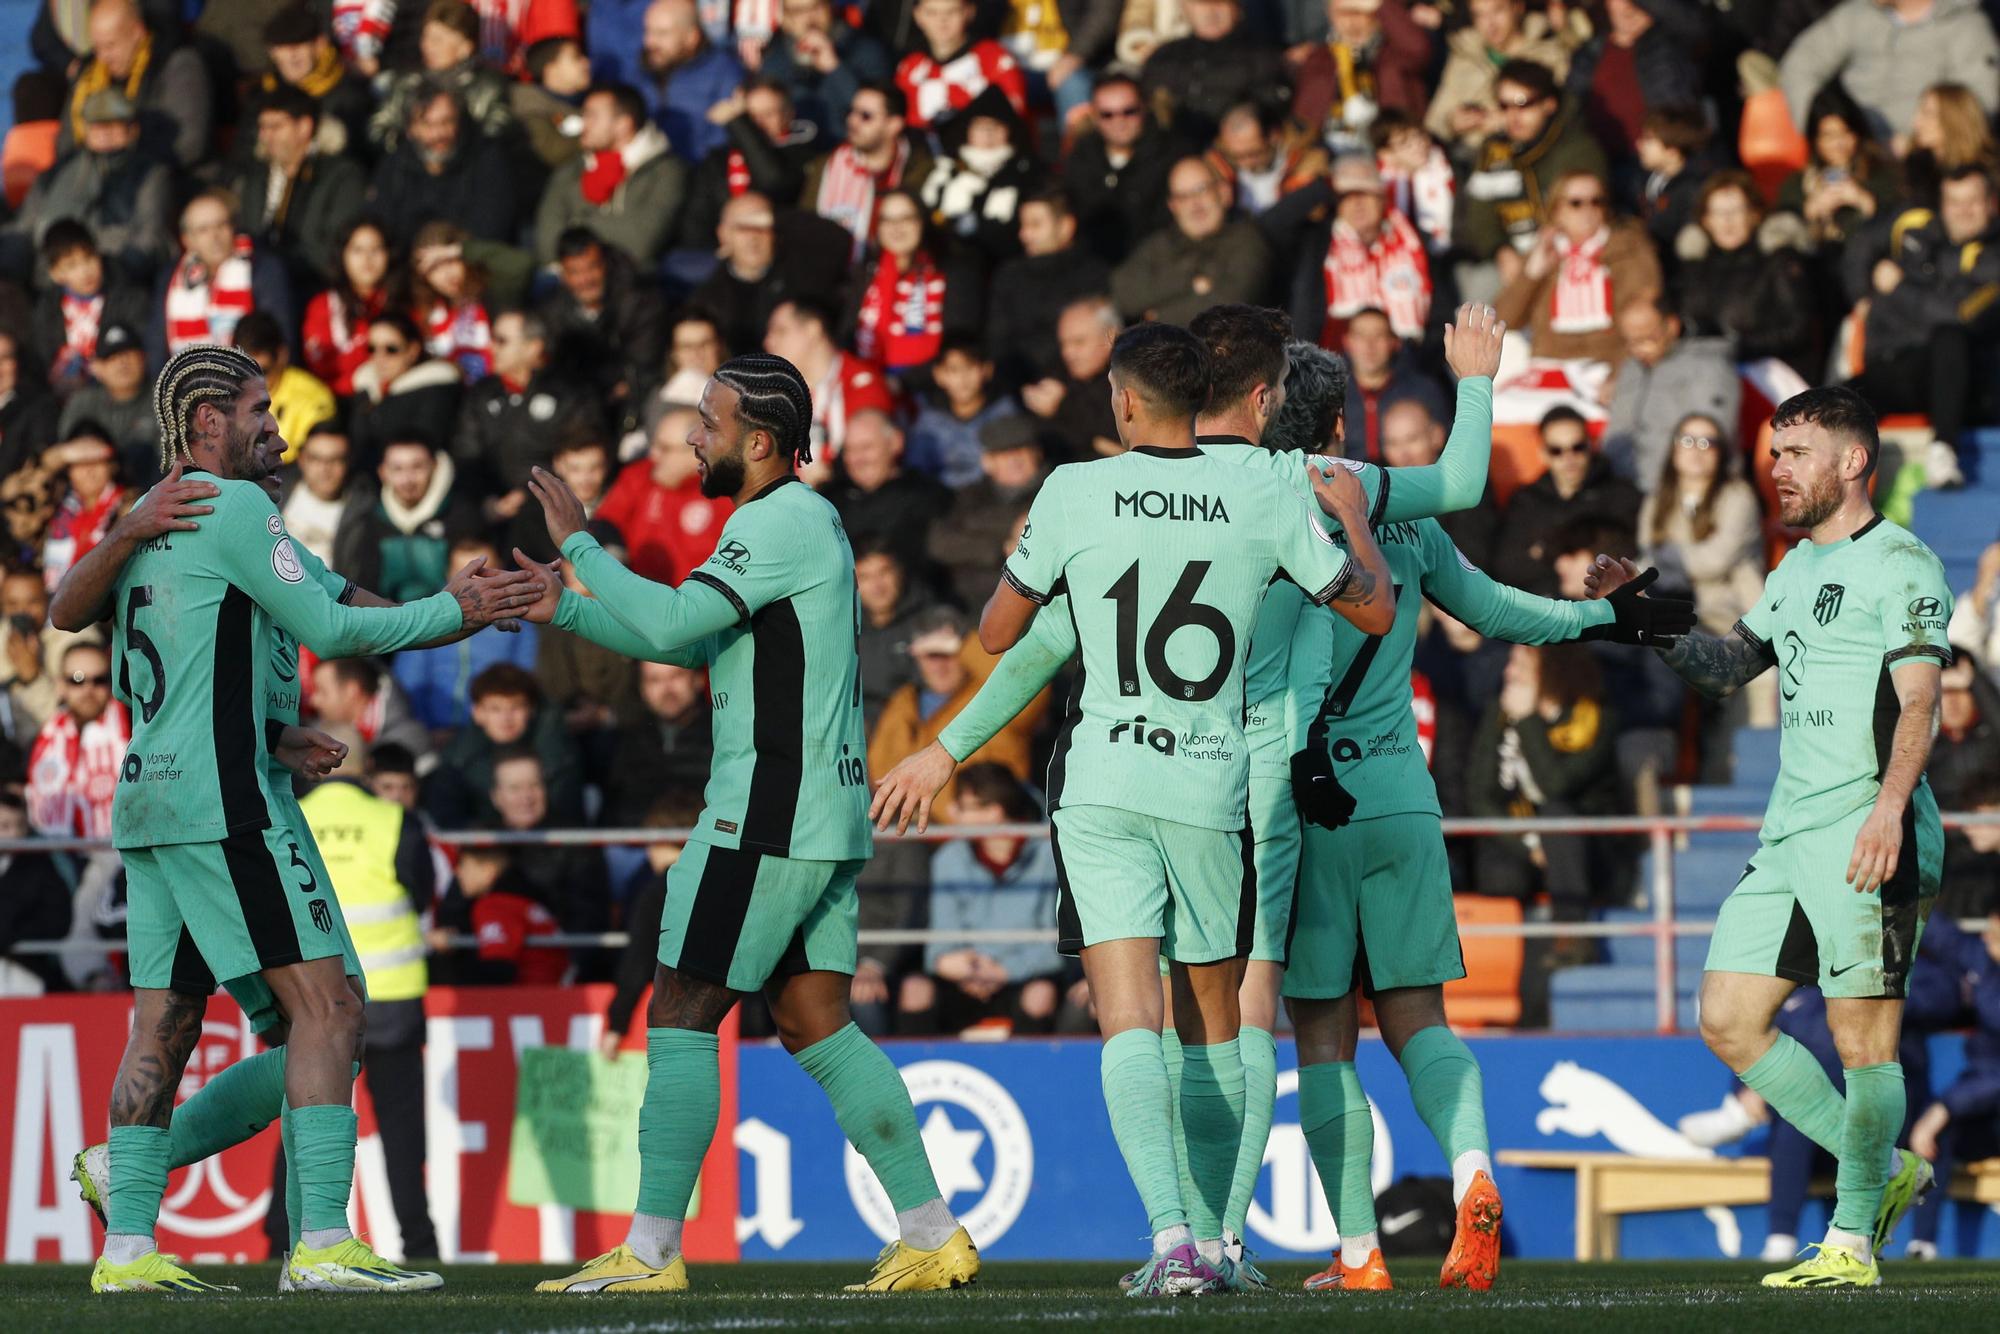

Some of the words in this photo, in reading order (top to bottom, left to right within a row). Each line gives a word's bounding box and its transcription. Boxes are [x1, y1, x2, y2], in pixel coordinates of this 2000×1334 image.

[1114, 490, 1231, 524] MOLINA
[1102, 557, 1236, 702] 16
[119, 585, 167, 725] 5
[1109, 714, 1176, 756] ria
[1804, 709, 1834, 727] AIR
[1180, 747, 1233, 761] Transfer
[1181, 731, 1226, 747] Money
[142, 766, 183, 782] Transfer
[838, 743, 864, 786] ria
[286, 842, 316, 893] 5
